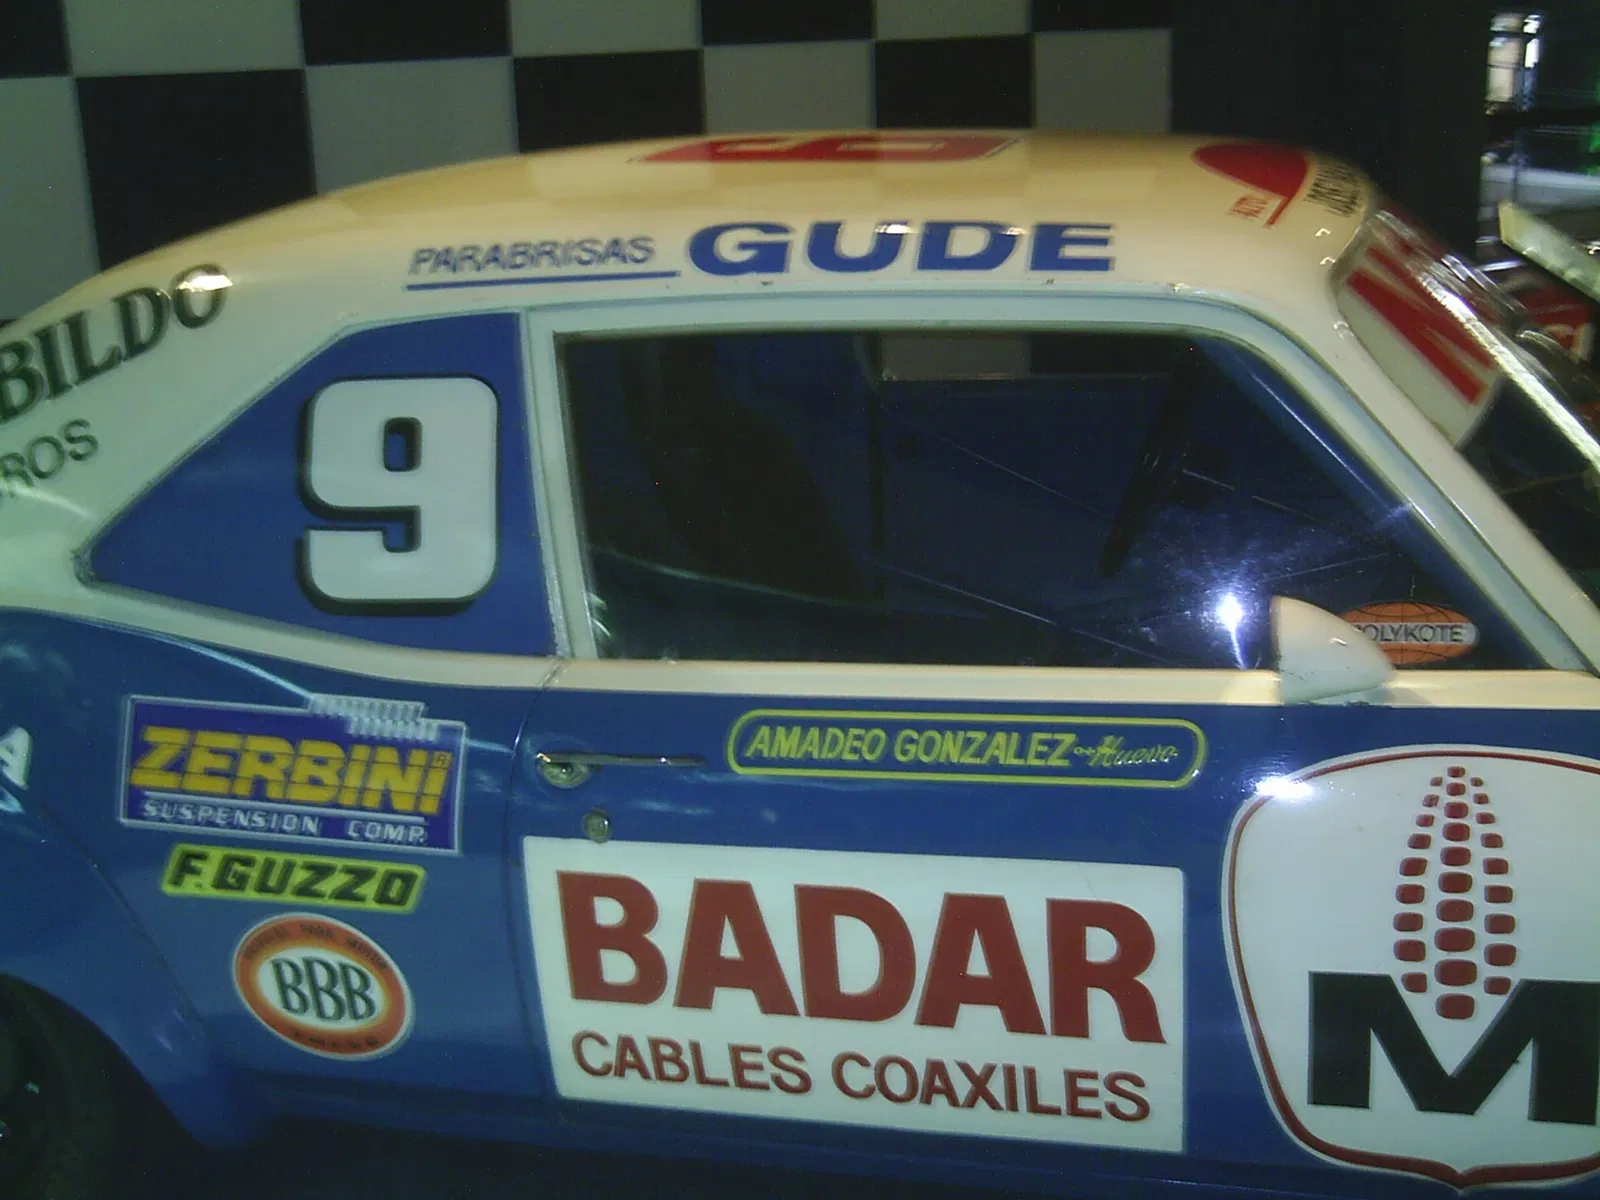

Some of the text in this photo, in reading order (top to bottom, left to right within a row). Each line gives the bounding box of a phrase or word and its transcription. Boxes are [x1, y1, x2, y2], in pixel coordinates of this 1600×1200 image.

[407, 222, 1117, 275] PARABRISAS GUDE
[302, 375, 499, 612] 9
[1353, 622, 1464, 643] OLYKOTE
[131, 724, 453, 815] ZERBINI
[745, 725, 886, 764] AMADEO
[893, 731, 1077, 767] GONZALEZ
[143, 800, 426, 843] SUSPENSION COMP.
[170, 852, 419, 907] F.GUZZO
[271, 955, 377, 1021] BBB
[556, 870, 1167, 1044] BADAR
[572, 1030, 1151, 1122] CABLES COAXILES
[1306, 970, 1600, 1126] M
